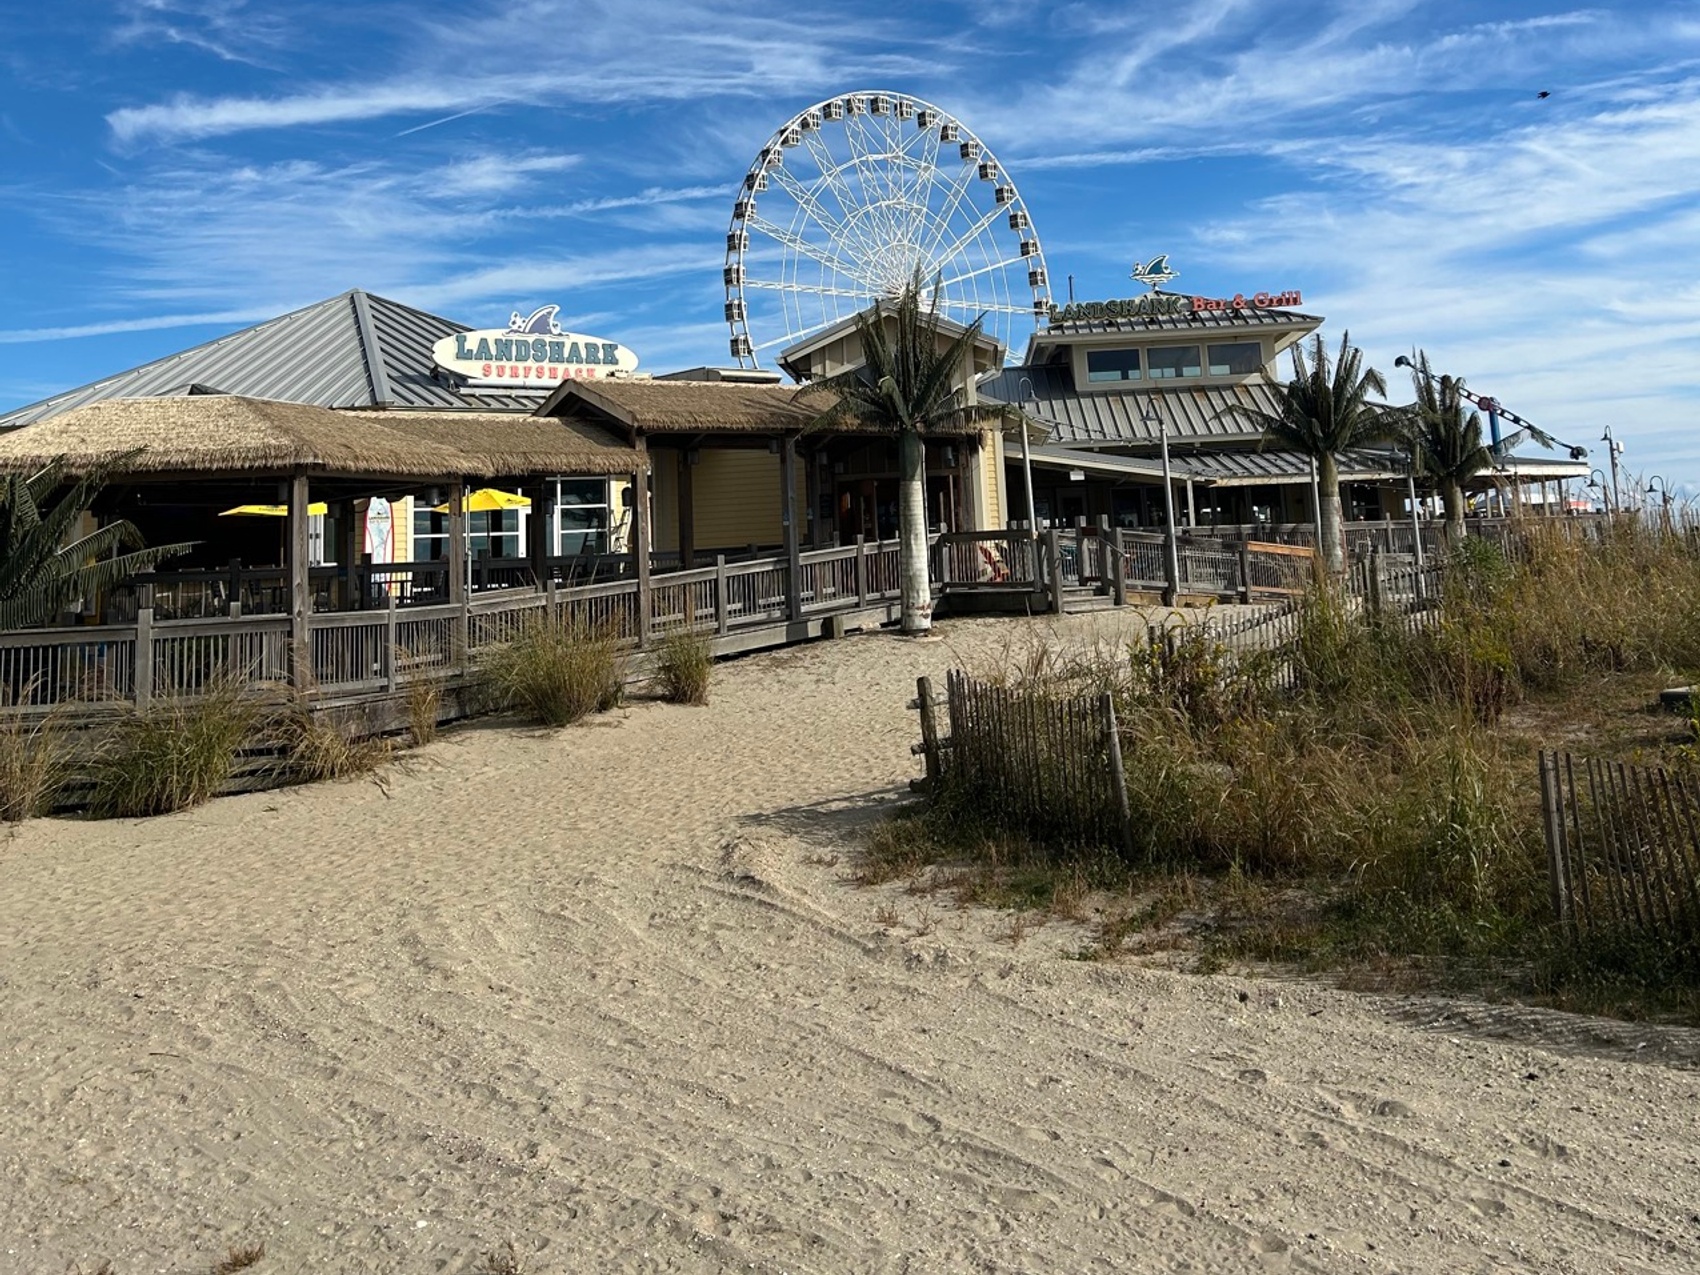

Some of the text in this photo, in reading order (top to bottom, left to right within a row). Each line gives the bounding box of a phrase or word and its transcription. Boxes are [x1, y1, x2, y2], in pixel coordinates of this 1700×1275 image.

[1050, 291, 1302, 322] LANDSHARK Bar & Grill
[455, 335, 619, 365] LANDSHARK
[482, 363, 596, 379] SURFSHACK
